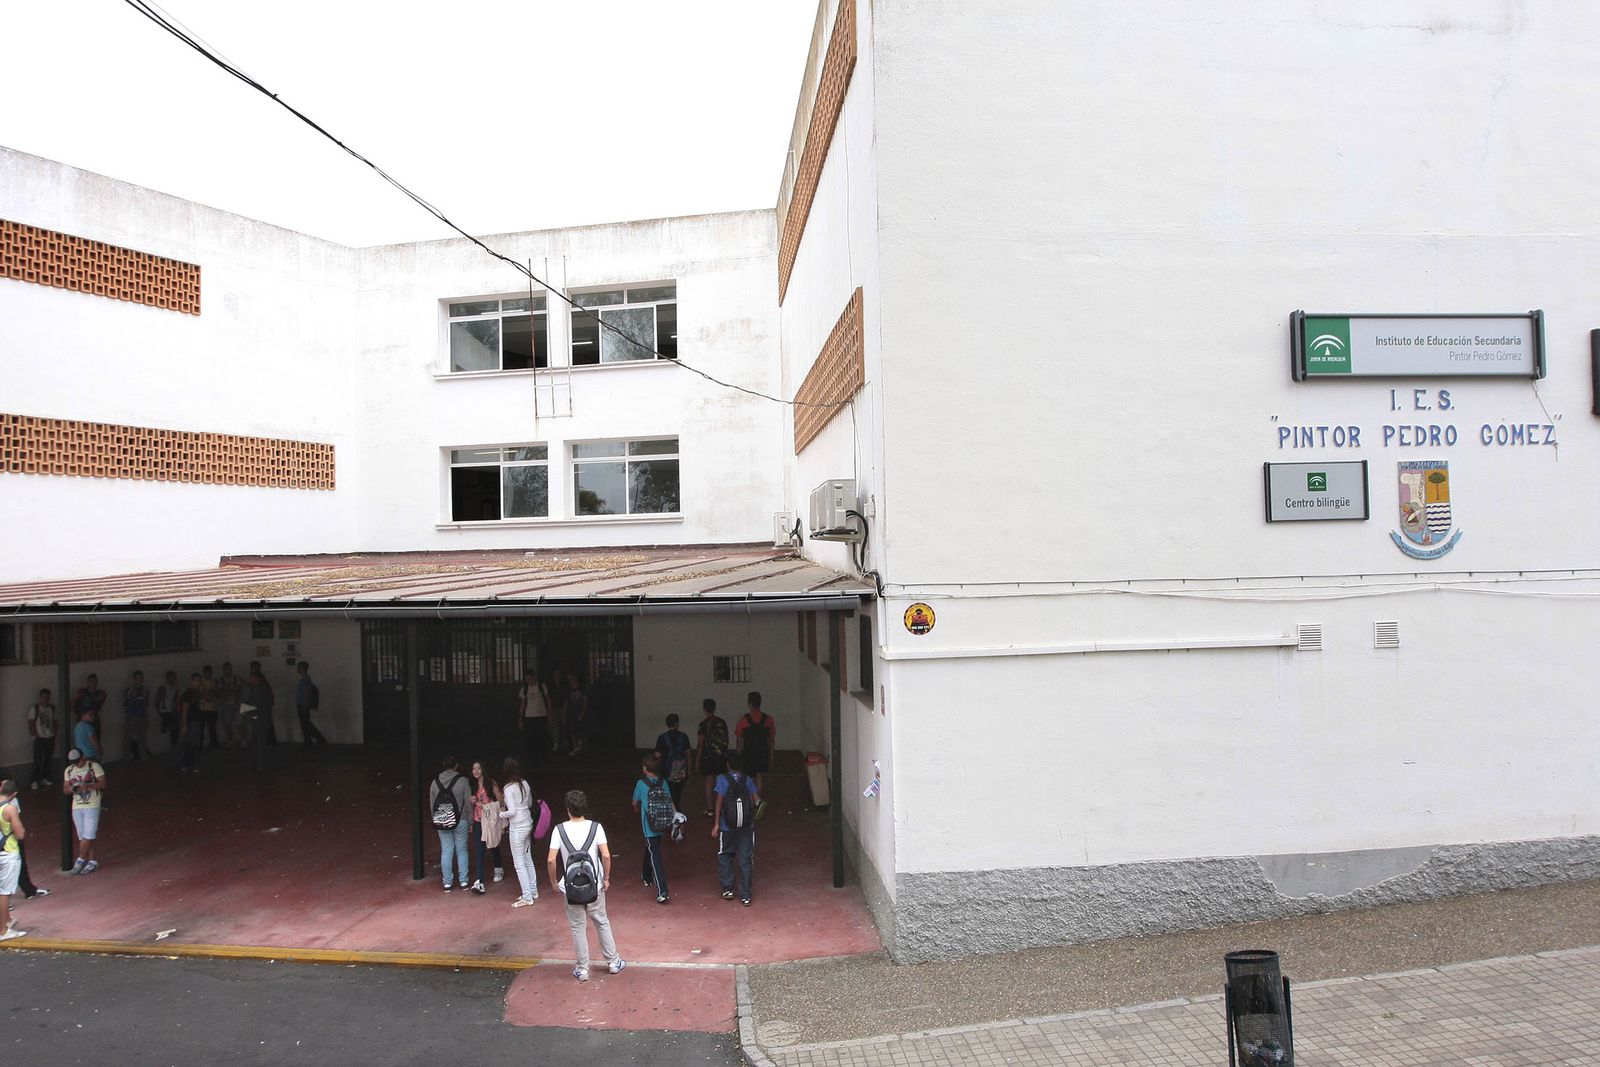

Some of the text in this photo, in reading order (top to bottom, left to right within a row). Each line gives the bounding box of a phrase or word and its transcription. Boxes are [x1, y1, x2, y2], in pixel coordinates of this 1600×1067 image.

[1375, 335, 1522, 346] Instituto de Educación Secundaria
[1449, 350, 1471, 361] Pintor
[1473, 350, 1495, 361] Pedro
[1383, 425, 1458, 447] PEDRO
[1285, 497, 1351, 509] Centro bilingüe
